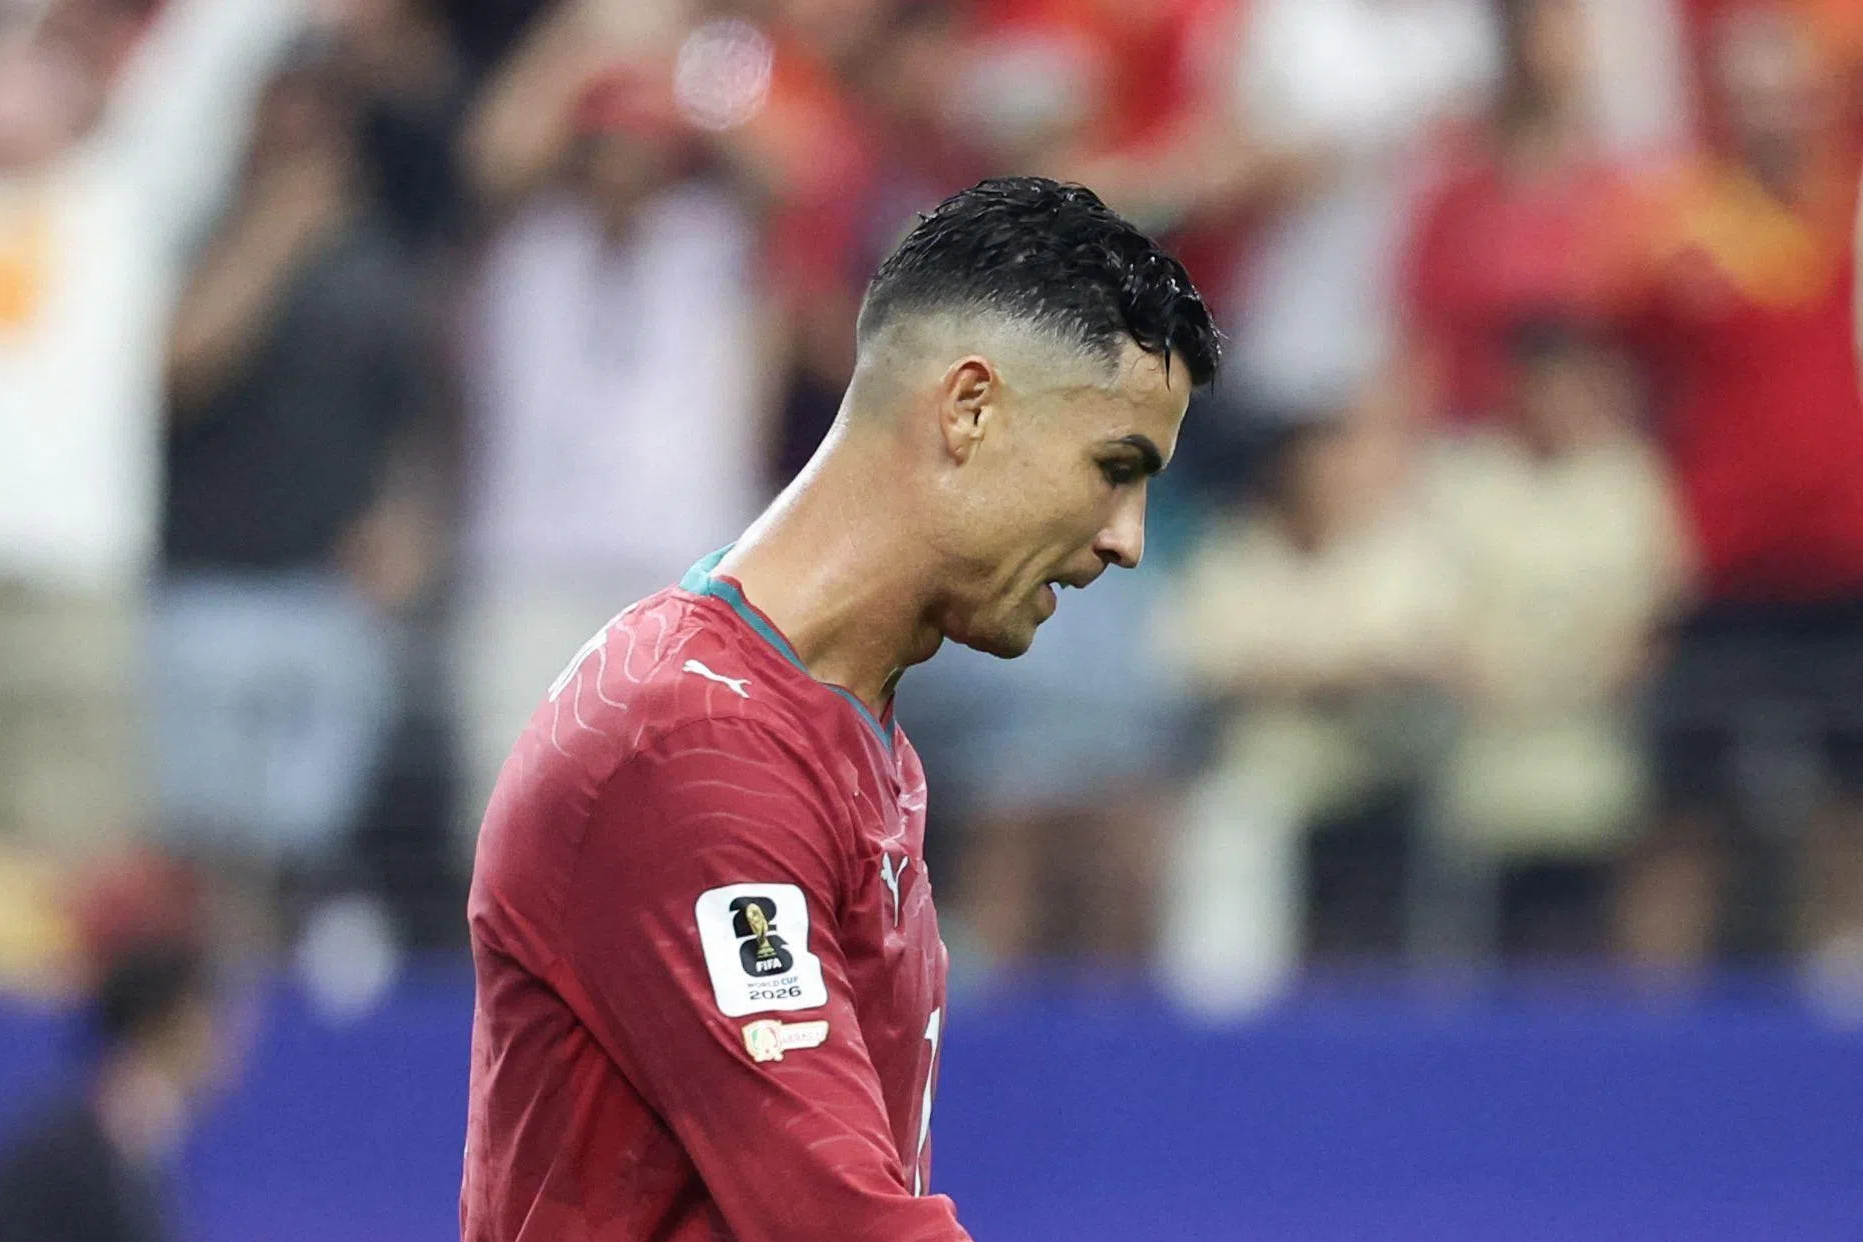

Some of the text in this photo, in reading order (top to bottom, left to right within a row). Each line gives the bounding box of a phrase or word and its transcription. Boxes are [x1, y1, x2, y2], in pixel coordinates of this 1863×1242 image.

[756, 957, 782, 972] FIFA
[781, 976, 799, 985] CUP
[749, 985, 801, 1000] 2026
